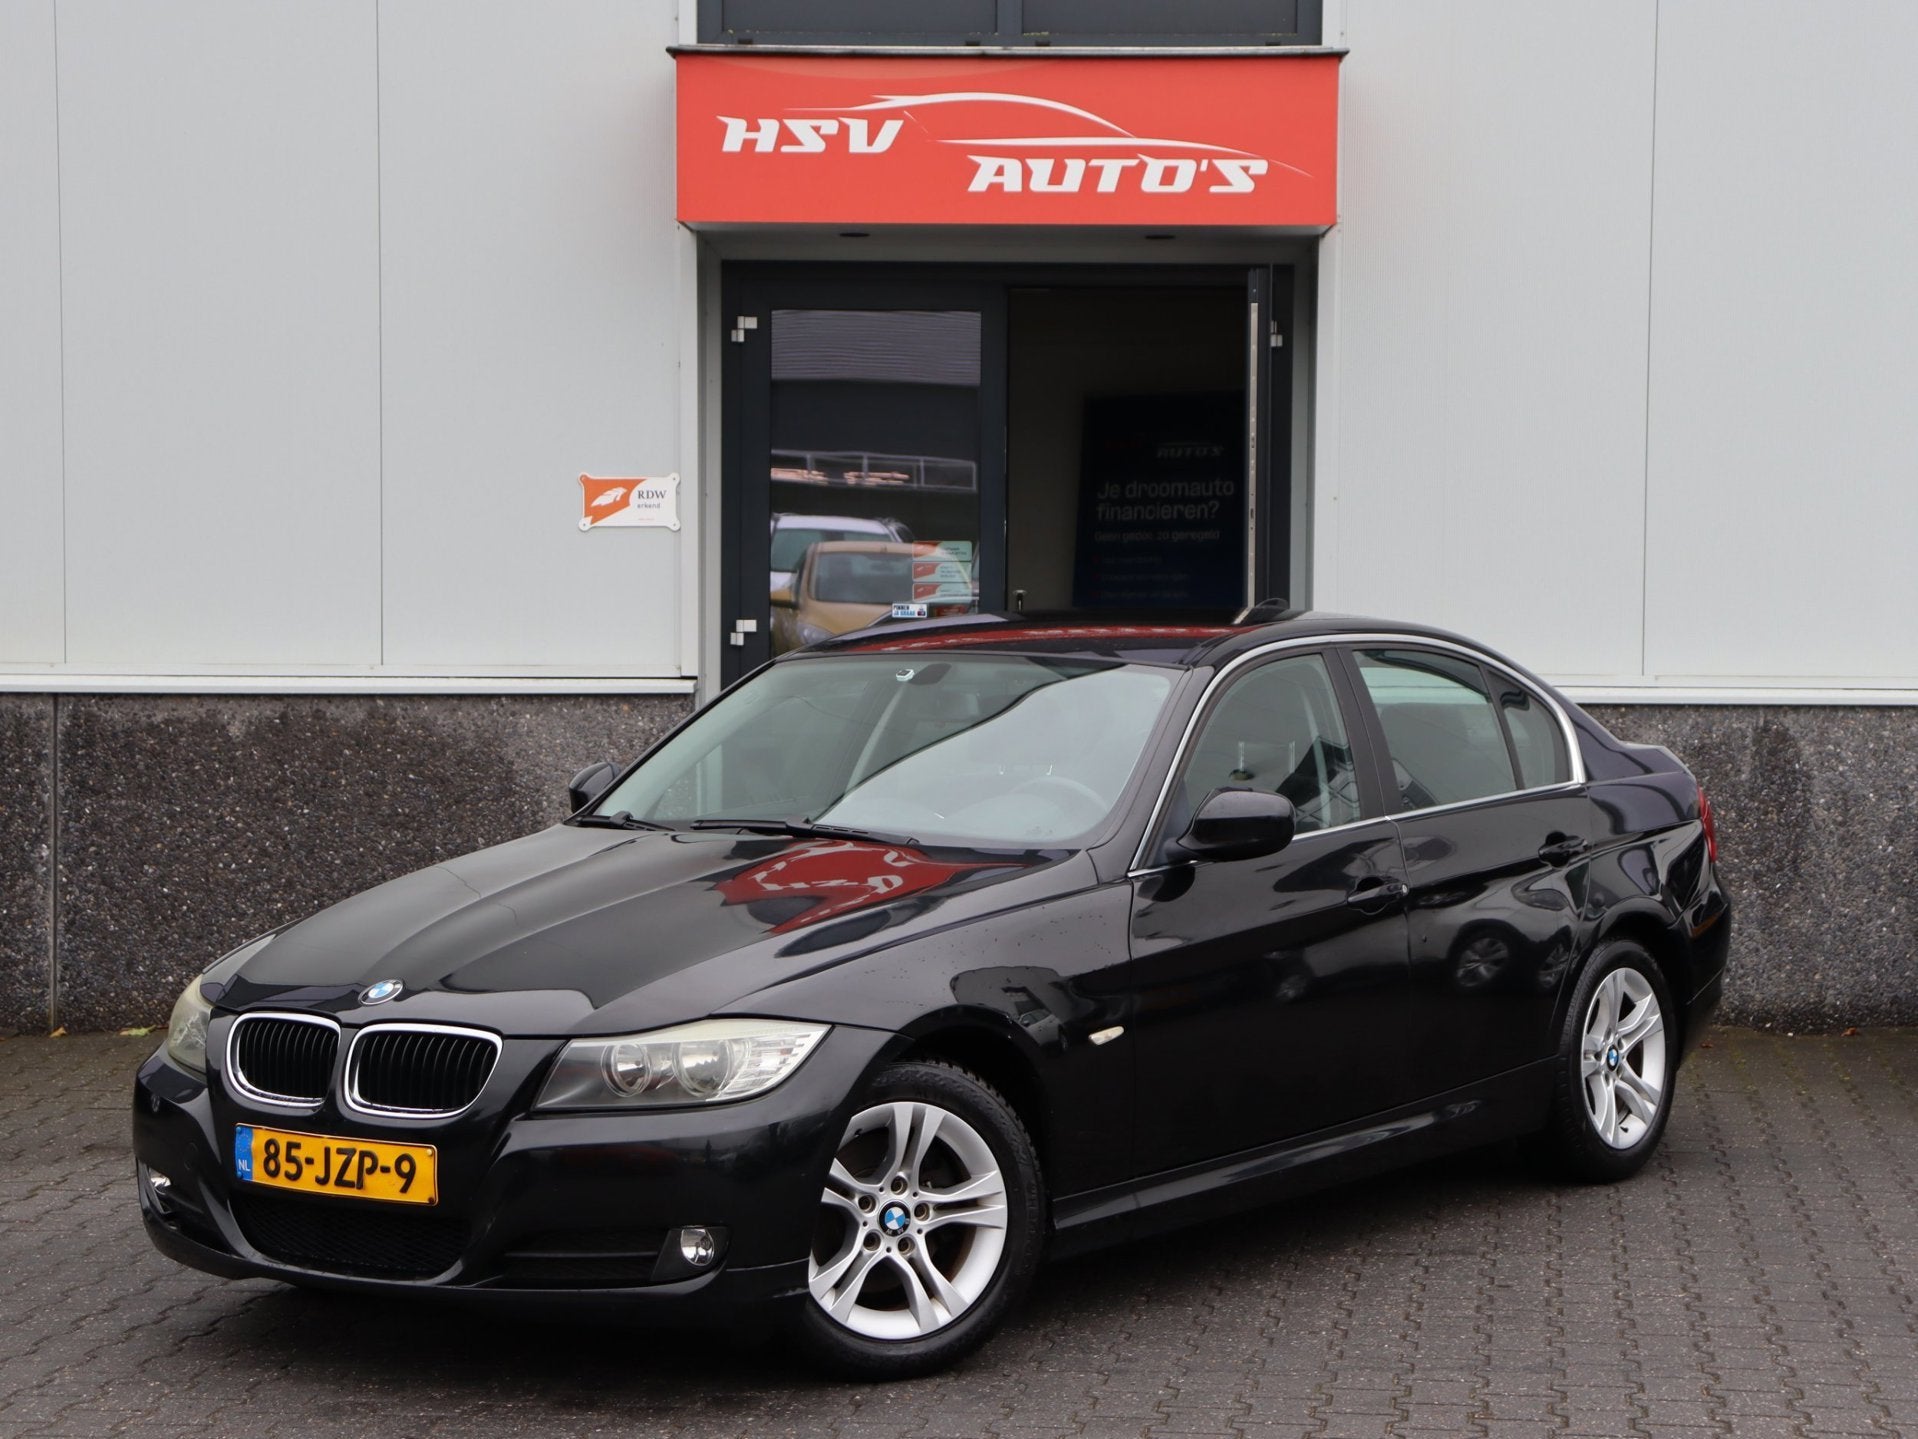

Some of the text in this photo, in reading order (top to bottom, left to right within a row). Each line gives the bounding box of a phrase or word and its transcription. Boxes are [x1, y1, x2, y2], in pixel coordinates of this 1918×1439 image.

[715, 114, 905, 154] HSV
[966, 152, 1269, 194] AUTO'S
[638, 490, 667, 499] RDW
[1097, 477, 1235, 499] Je droomauto
[1096, 501, 1220, 520] financieren?
[238, 1158, 251, 1172] NL
[262, 1137, 417, 1194] 85-JZP-9
